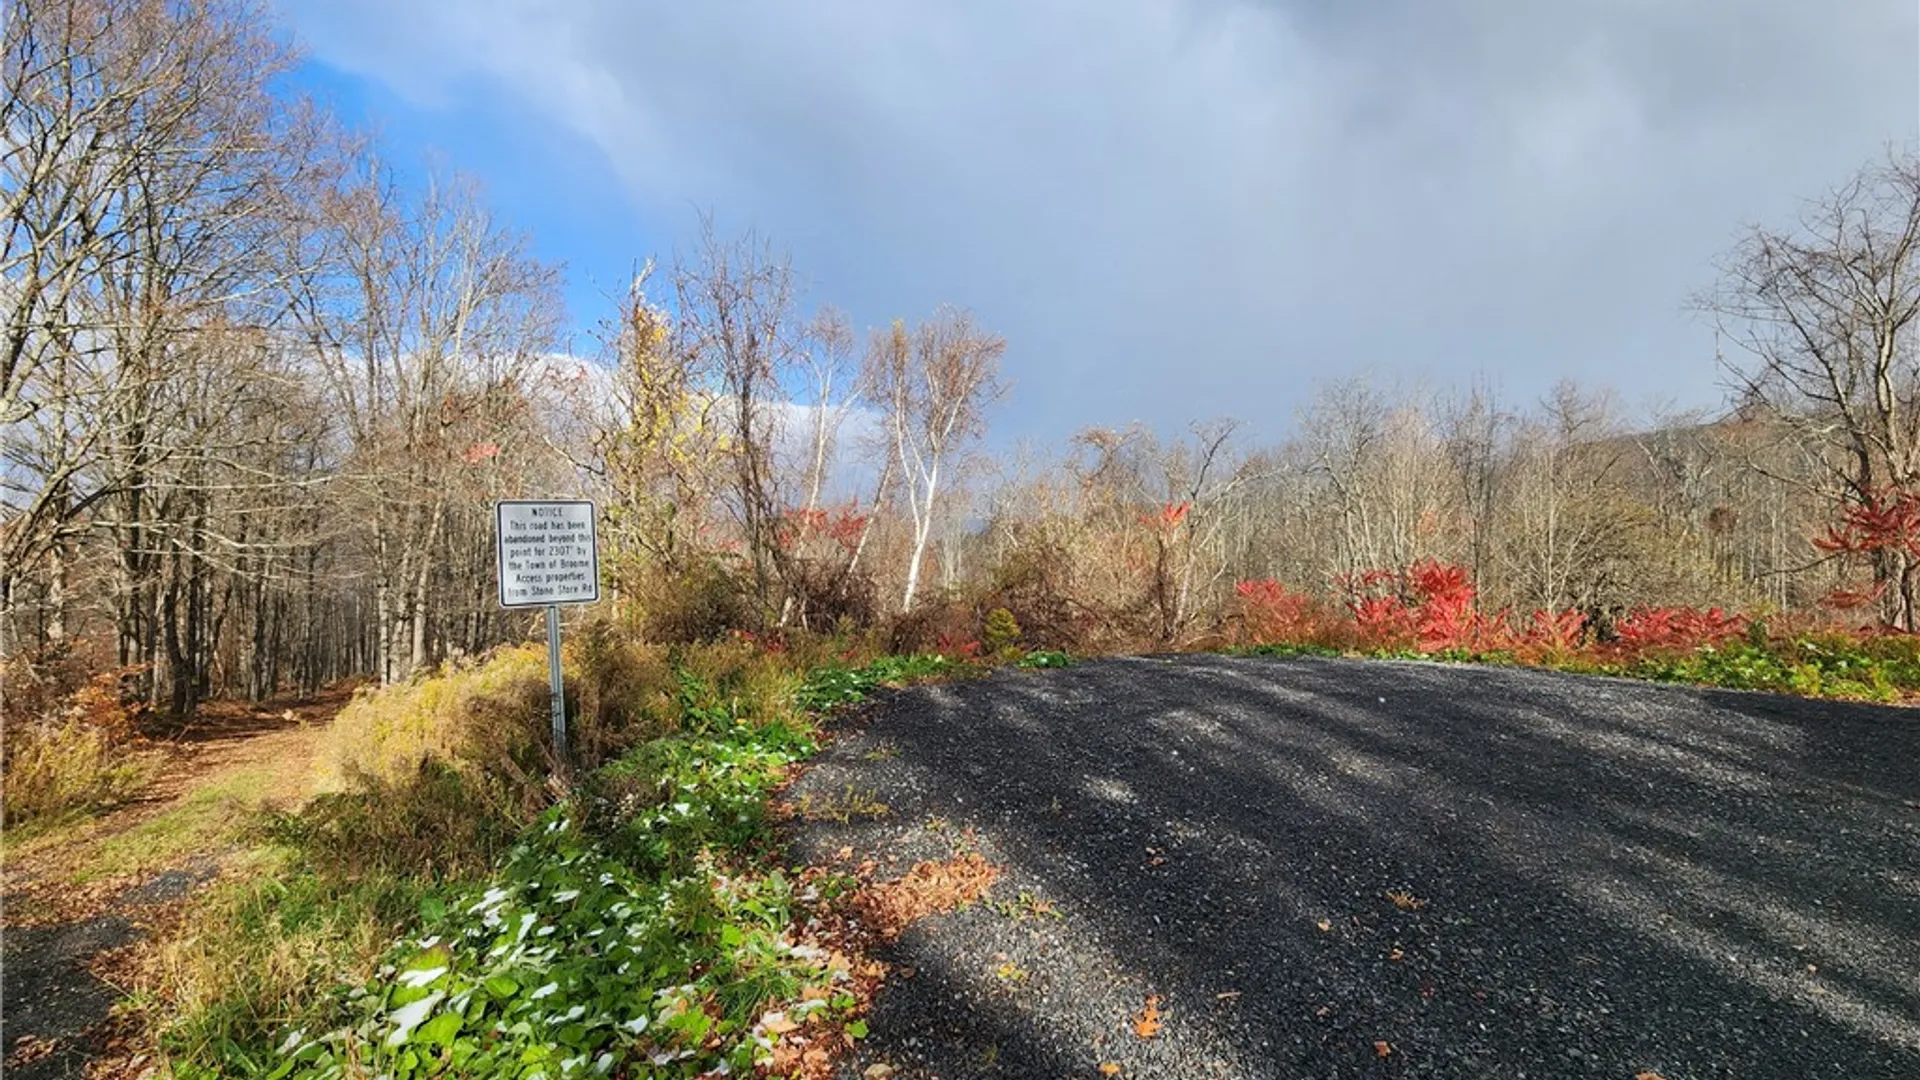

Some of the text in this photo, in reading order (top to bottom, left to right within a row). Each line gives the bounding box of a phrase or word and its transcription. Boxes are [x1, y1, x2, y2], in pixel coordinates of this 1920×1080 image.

[531, 507, 563, 517] NOTICE
[510, 520, 586, 530] This road has been
[504, 533, 592, 545] abandoned beyond this
[510, 547, 532, 559] point
[534, 546, 545, 556] for
[577, 546, 587, 557] by
[508, 558, 590, 570] the Town of Broome
[516, 572, 585, 584] Access properties
[508, 587, 528, 597] from
[531, 586, 554, 596] Stone
[557, 584, 579, 595] Store
